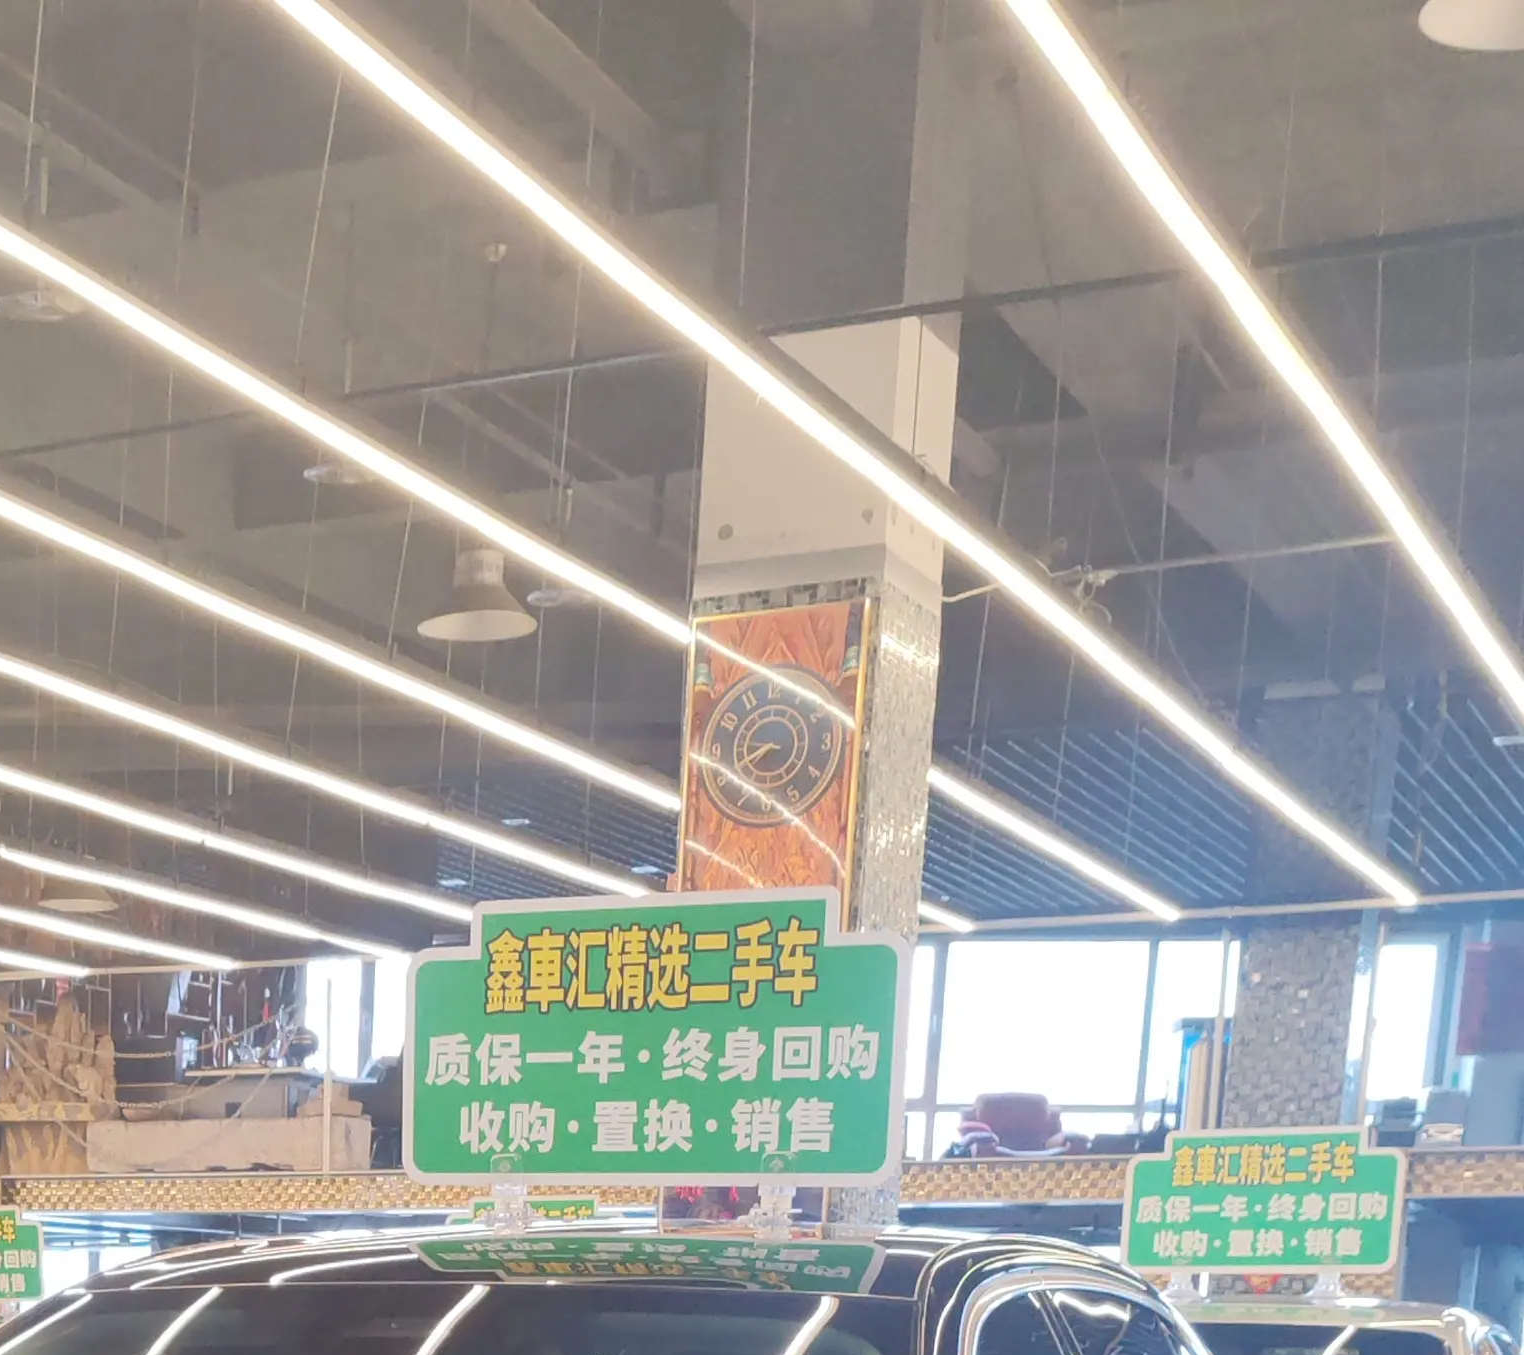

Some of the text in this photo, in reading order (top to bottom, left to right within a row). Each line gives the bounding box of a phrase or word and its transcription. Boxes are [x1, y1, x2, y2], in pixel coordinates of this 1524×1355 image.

[484, 916, 819, 1013] 鑫車汇精选二手车
[425, 1024, 879, 1087] 质保一年·终身回购
[459, 1097, 835, 1154] 收购·置换·销售
[1172, 1140, 1356, 1187] 鑫車汇精选二手车
